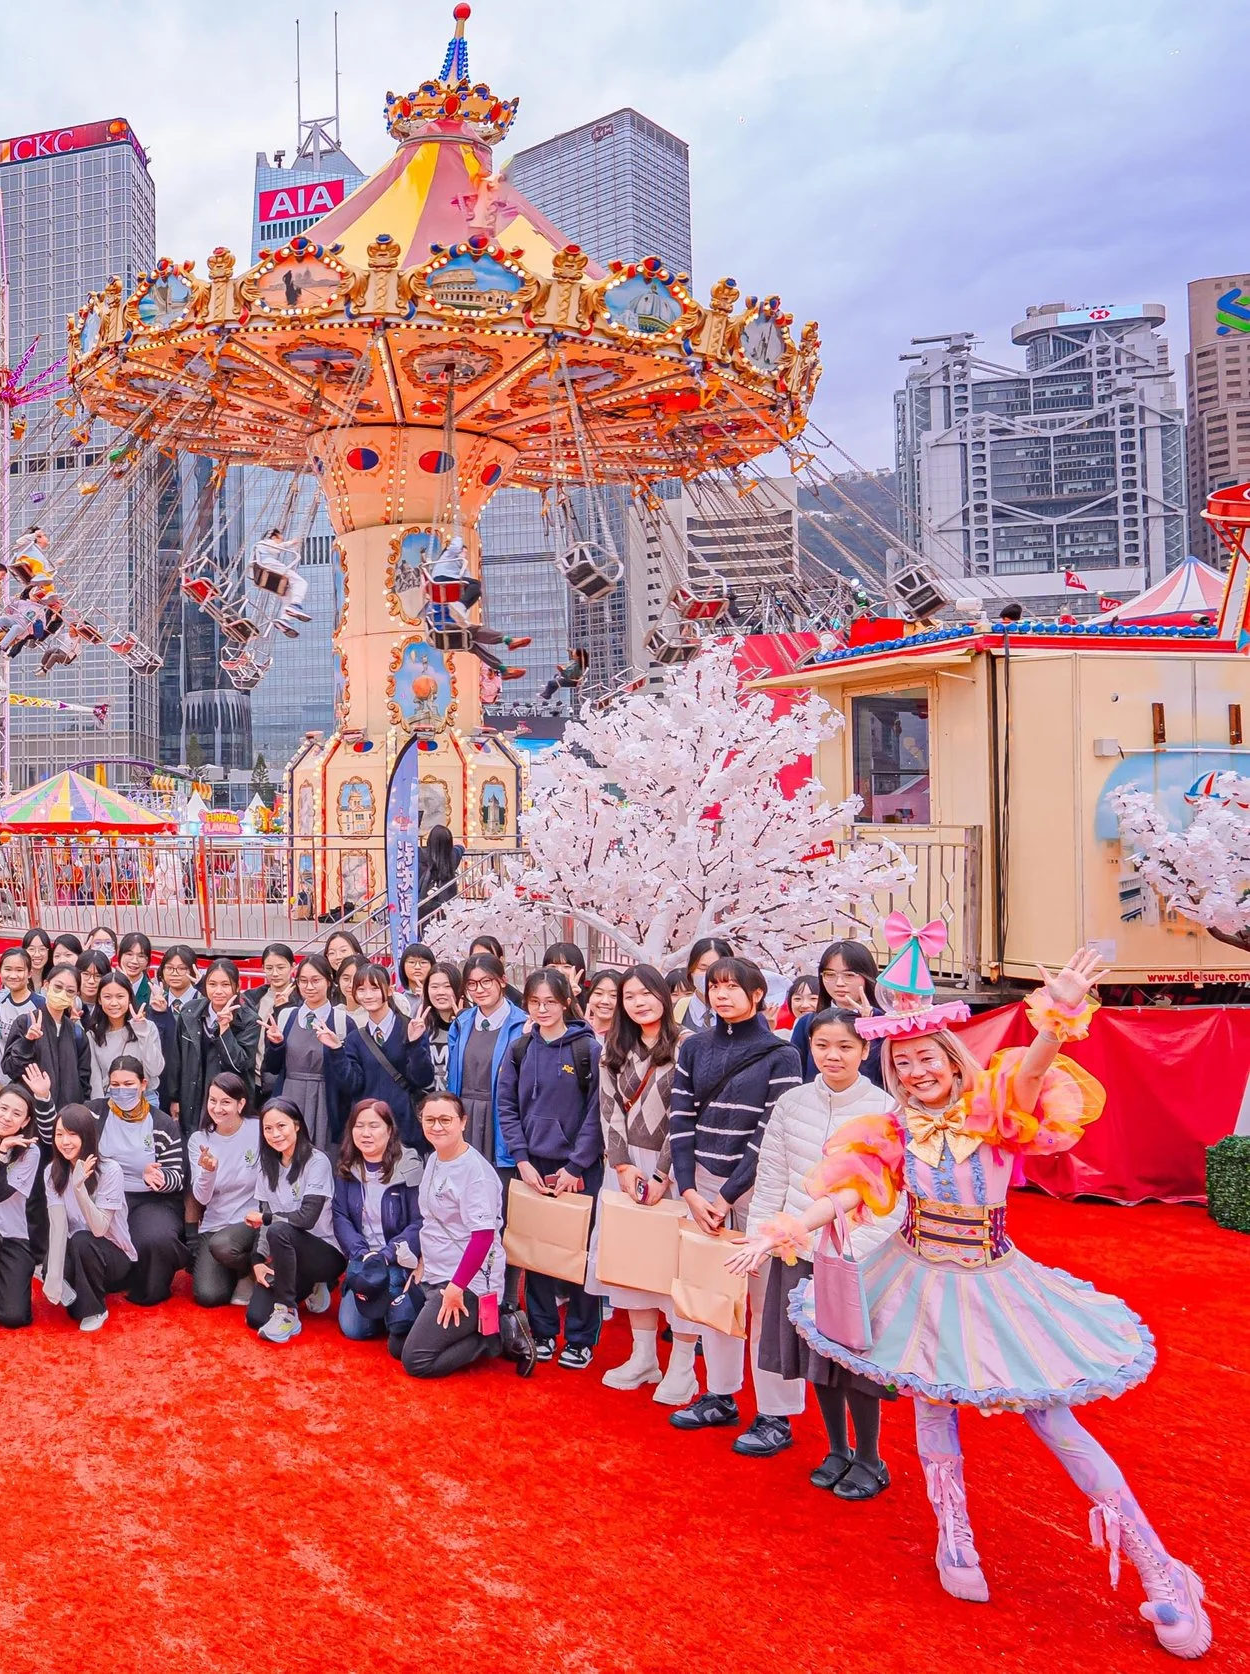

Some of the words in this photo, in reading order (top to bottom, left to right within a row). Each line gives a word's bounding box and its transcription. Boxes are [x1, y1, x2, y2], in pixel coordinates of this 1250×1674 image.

[13, 130, 75, 160] CKC
[269, 186, 335, 217] AIA
[206, 812, 239, 825] FUNFAIR
[1147, 971, 1250, 983] www.sdleisure.com
